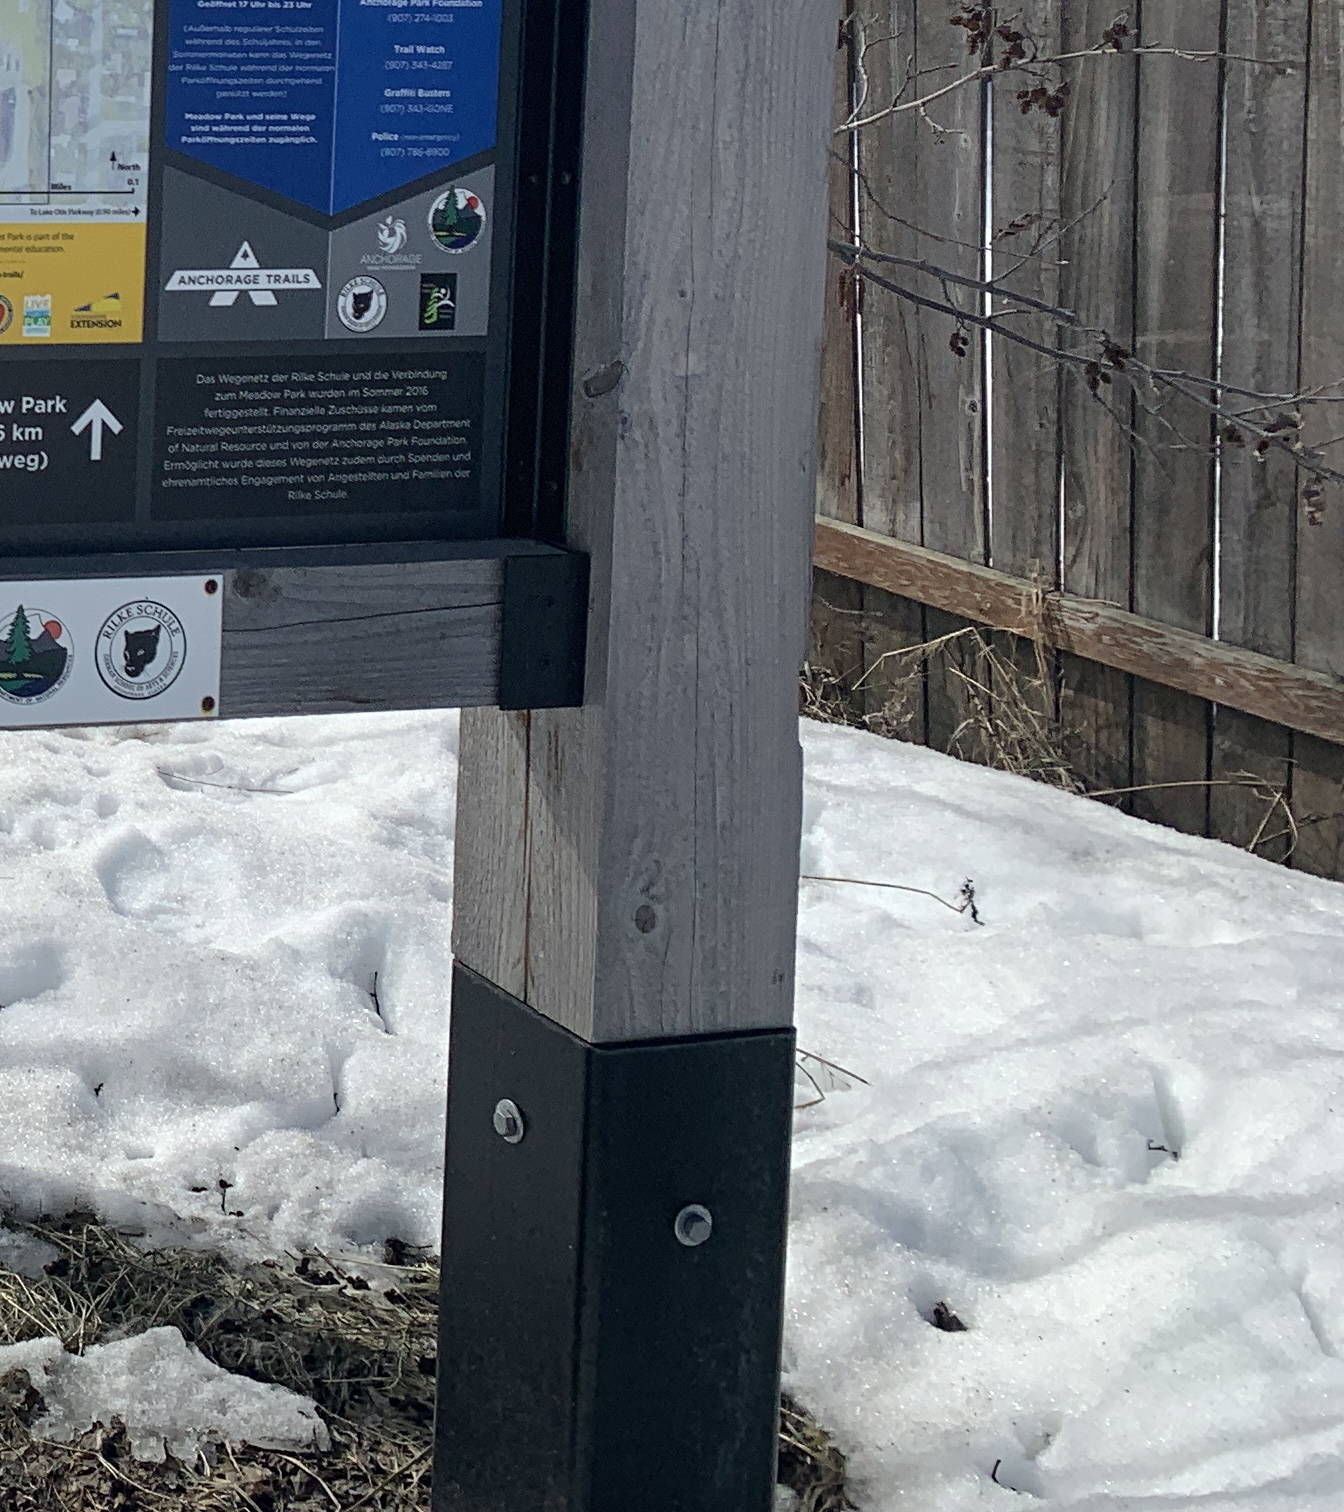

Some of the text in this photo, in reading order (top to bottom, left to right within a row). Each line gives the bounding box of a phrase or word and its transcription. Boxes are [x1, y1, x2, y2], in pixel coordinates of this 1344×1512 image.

[432, 0, 483, 7] Foundation
[394, 45, 445, 54] Trail Watch
[127, 178, 139, 186] 0.1
[178, 274, 310, 285] ANCHORAGE TRAILS
[25, 318, 51, 327] PLAY
[71, 320, 122, 328] EXTENSION
[196, 370, 447, 385] Das Wegenetz der Rilke Schule und die Verbindung
[22, 397, 67, 413] Park
[13, 424, 42, 441] km
[103, 604, 182, 641] RILKE SCHULE
